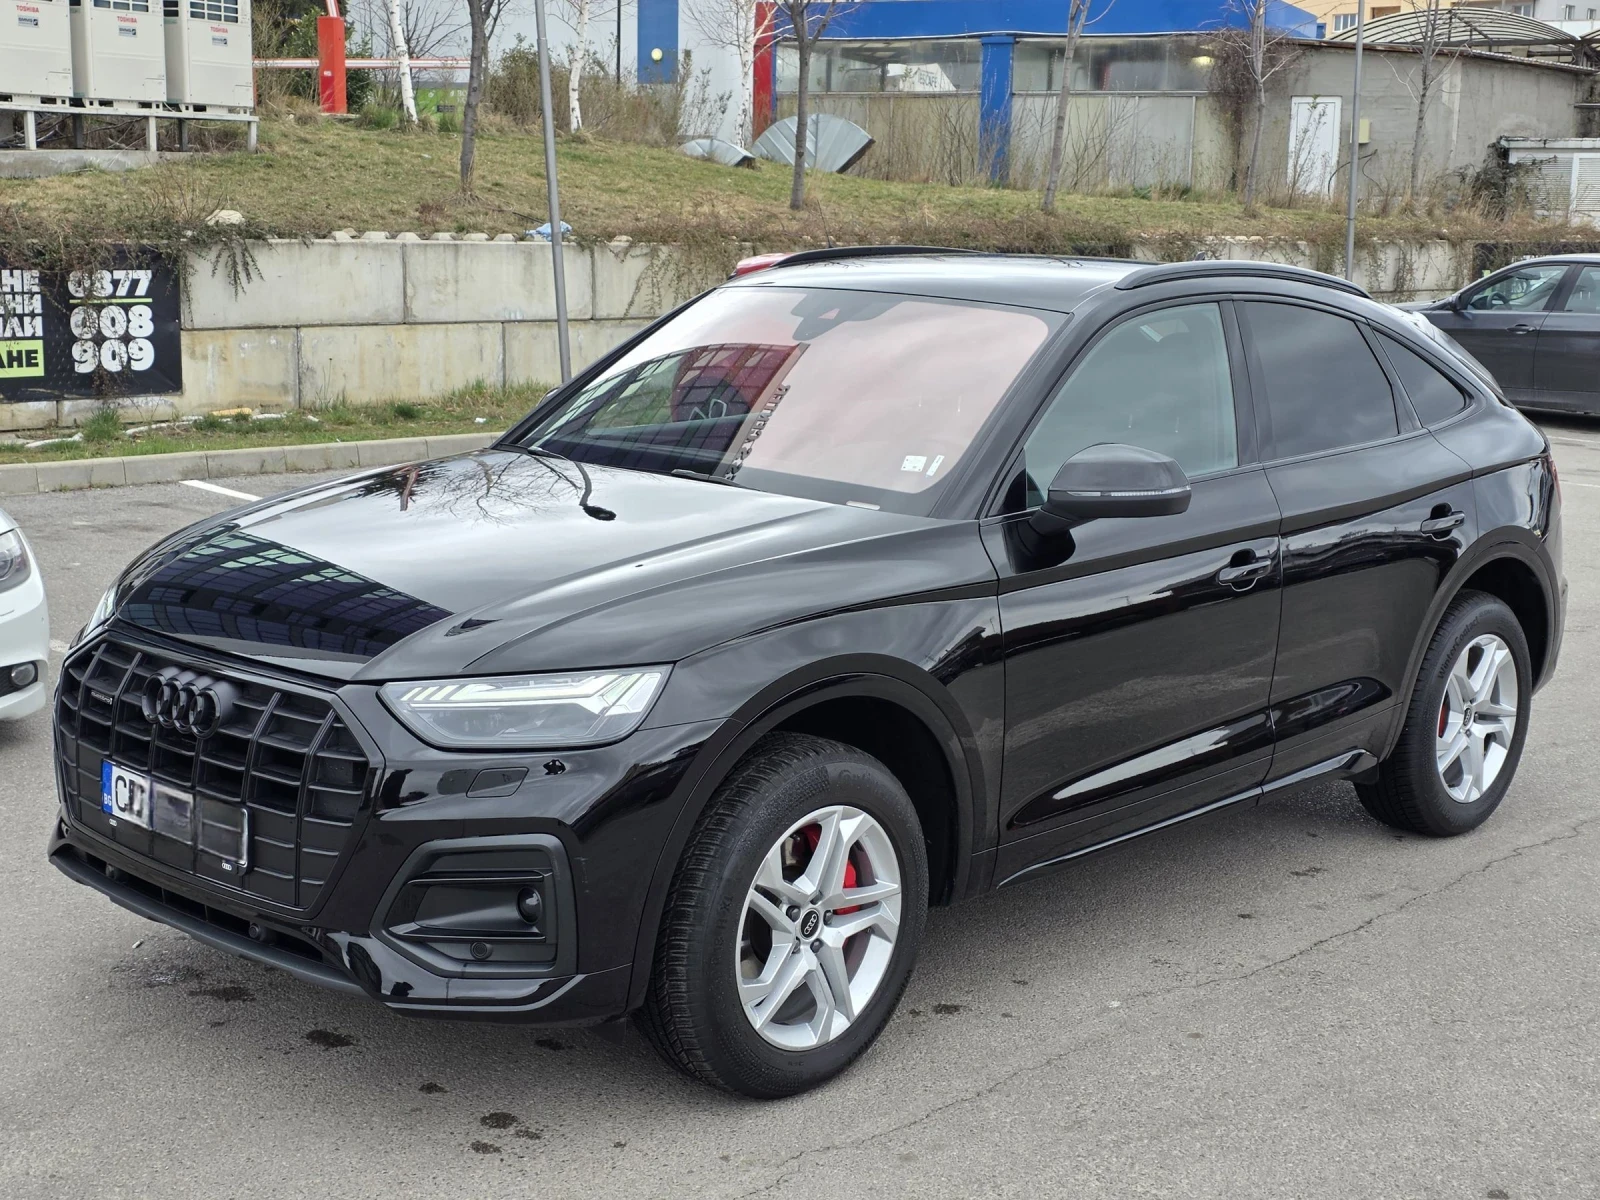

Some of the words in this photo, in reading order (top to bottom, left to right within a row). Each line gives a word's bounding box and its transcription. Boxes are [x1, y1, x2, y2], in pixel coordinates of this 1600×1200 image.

[0, 270, 40, 292] НЕ
[68, 270, 152, 297] 0877
[0, 315, 43, 338] ЛИ
[72, 338, 155, 374] 909
[1438, 616, 1479, 679] WinterContact
[103, 793, 112, 807] BG
